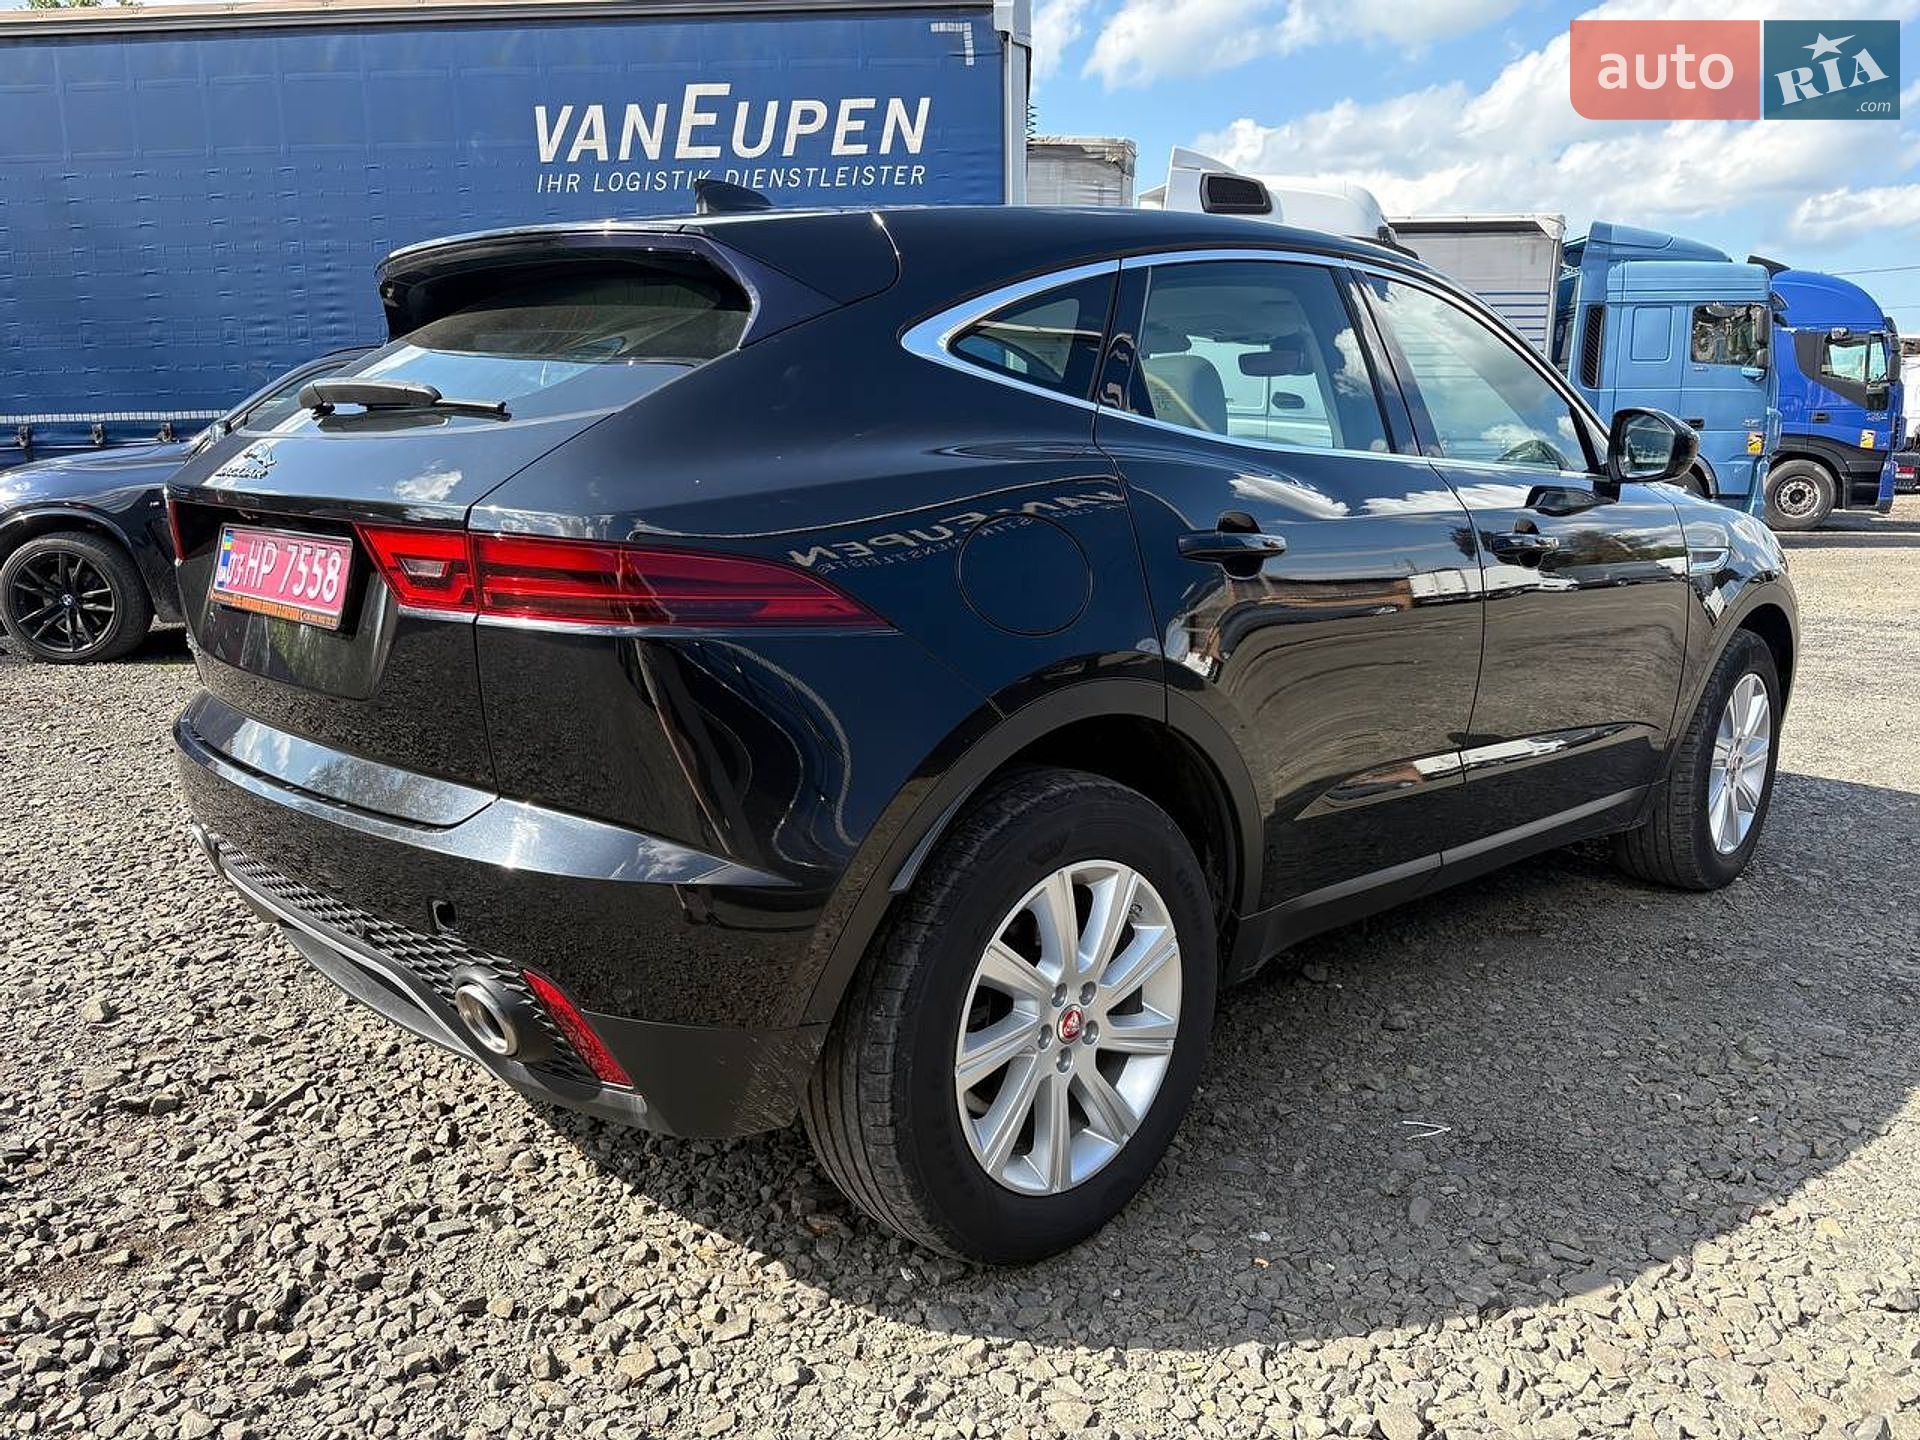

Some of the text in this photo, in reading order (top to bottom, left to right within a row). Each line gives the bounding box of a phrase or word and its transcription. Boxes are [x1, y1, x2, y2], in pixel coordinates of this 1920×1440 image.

[537, 173, 580, 193] IHR
[243, 540, 278, 590] HP
[278, 544, 342, 603] 7558
